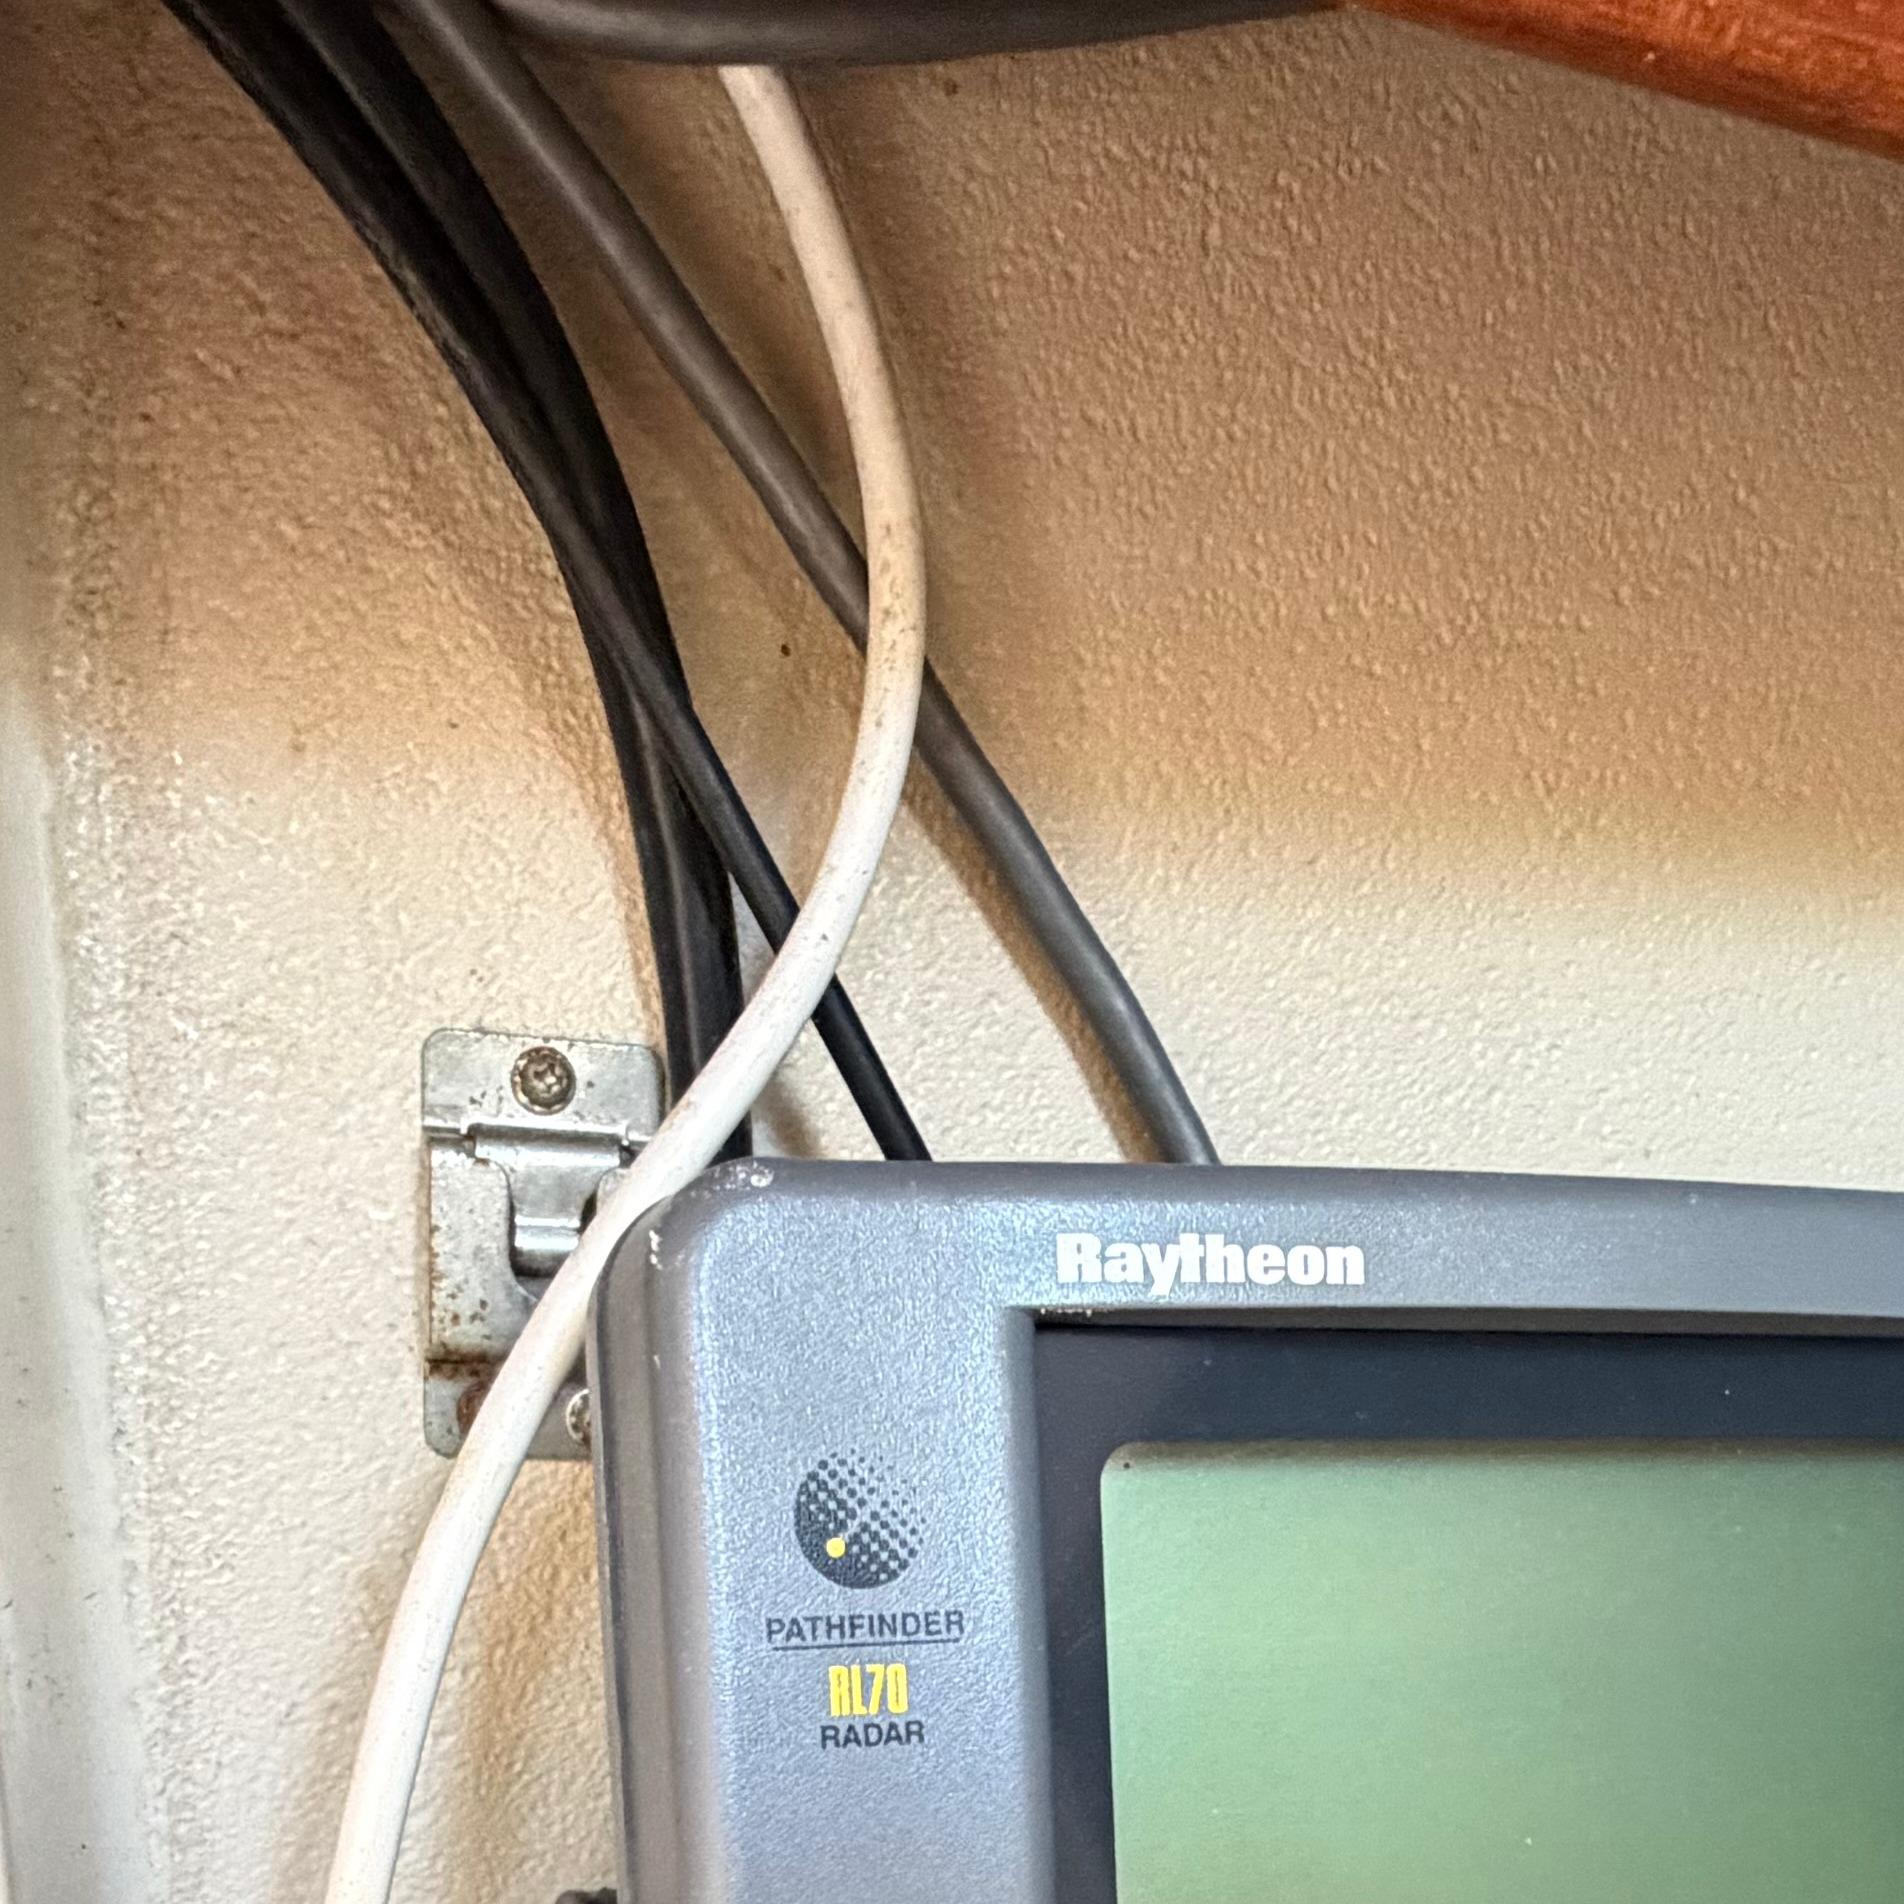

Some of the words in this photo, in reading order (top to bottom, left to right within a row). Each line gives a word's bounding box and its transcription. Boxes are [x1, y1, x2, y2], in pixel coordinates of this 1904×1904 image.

[1056, 1232, 1366, 1297] Raytheon
[765, 1610, 965, 1644] PATHFINDER
[828, 1663, 909, 1718] RL70
[820, 1720, 925, 1750] RADAR
